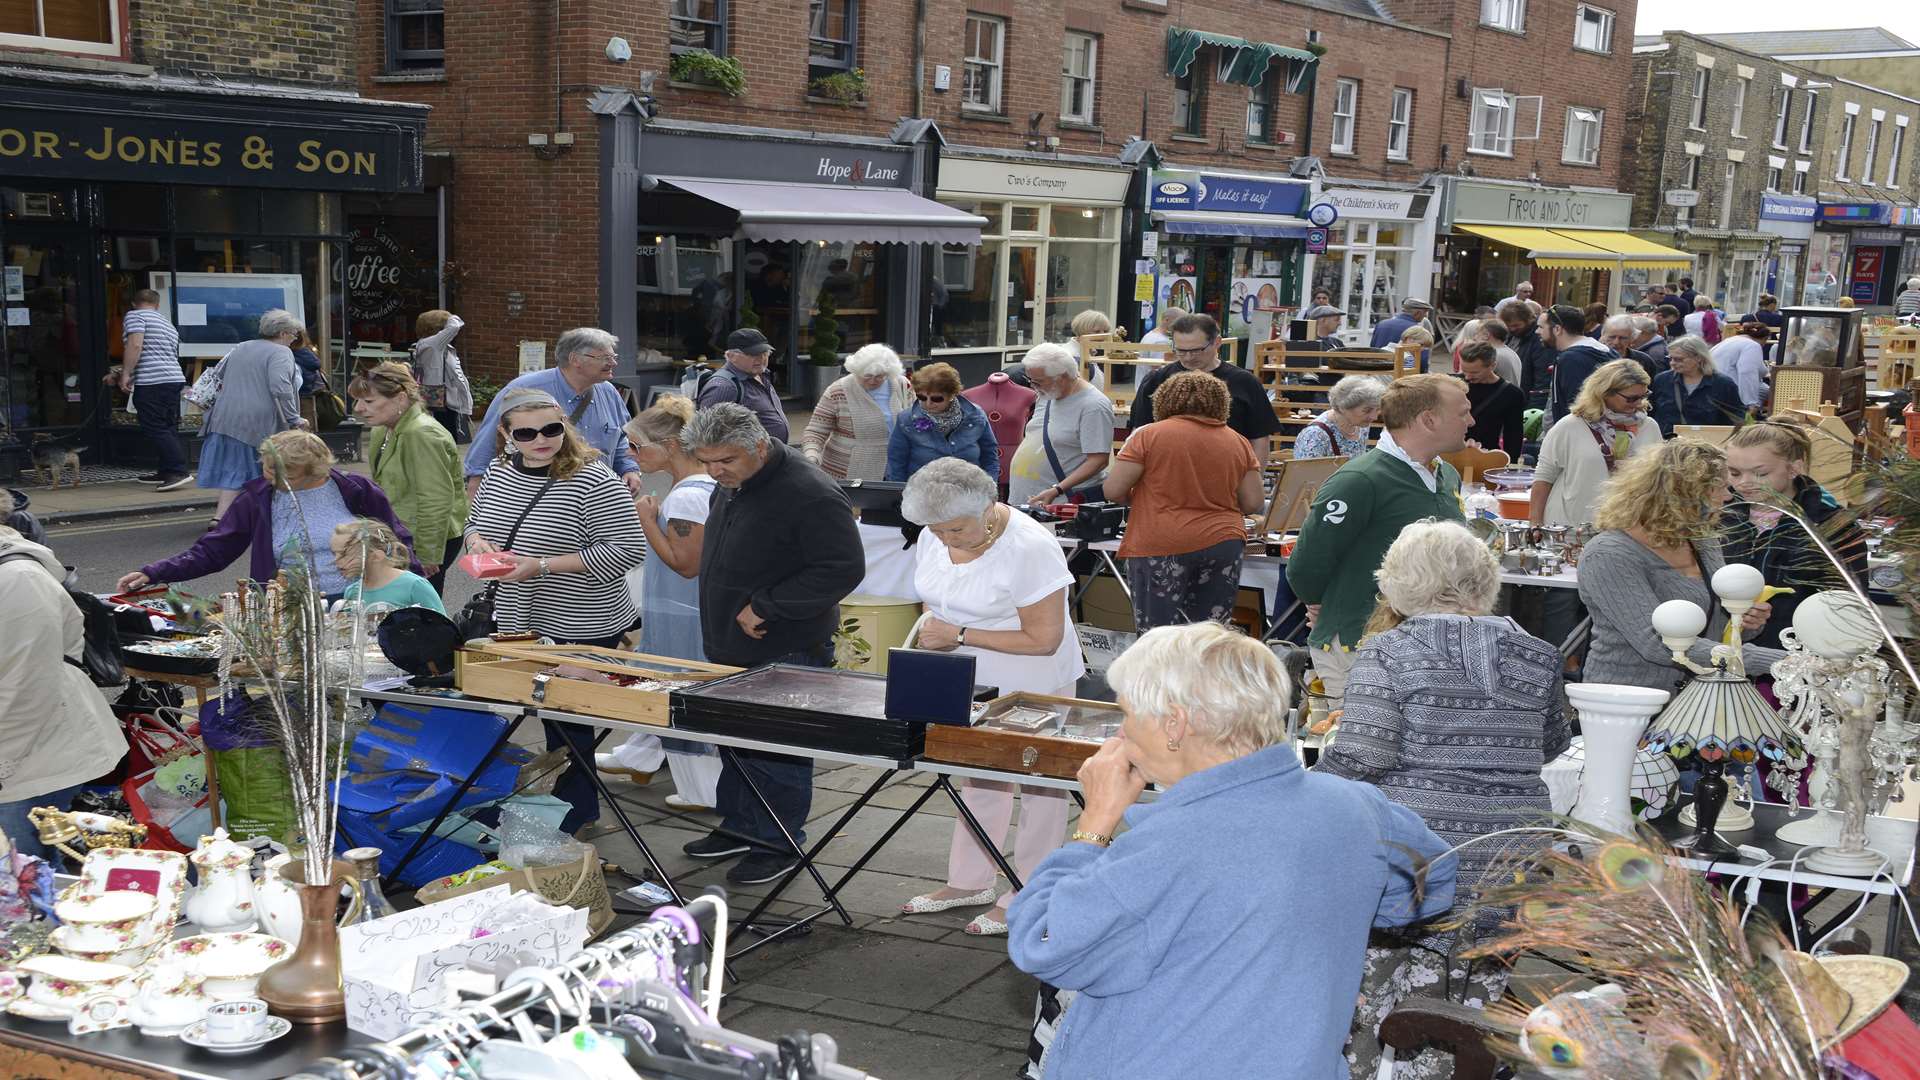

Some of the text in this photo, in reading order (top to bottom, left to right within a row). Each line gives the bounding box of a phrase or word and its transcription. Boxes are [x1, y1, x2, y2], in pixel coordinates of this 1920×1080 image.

[241, 135, 273, 170] &
[296, 140, 376, 176] SON
[817, 158, 898, 183] Hope & Lane
[1033, 176, 1067, 193] Company
[1212, 188, 1240, 201] Makes
[1242, 190, 1250, 201] it
[1329, 196, 1401, 213] The Children's Society
[1507, 193, 1537, 220] FROG
[1540, 201, 1560, 221] AND
[1861, 258, 1875, 272] 7
[1323, 499, 1348, 524] 2
